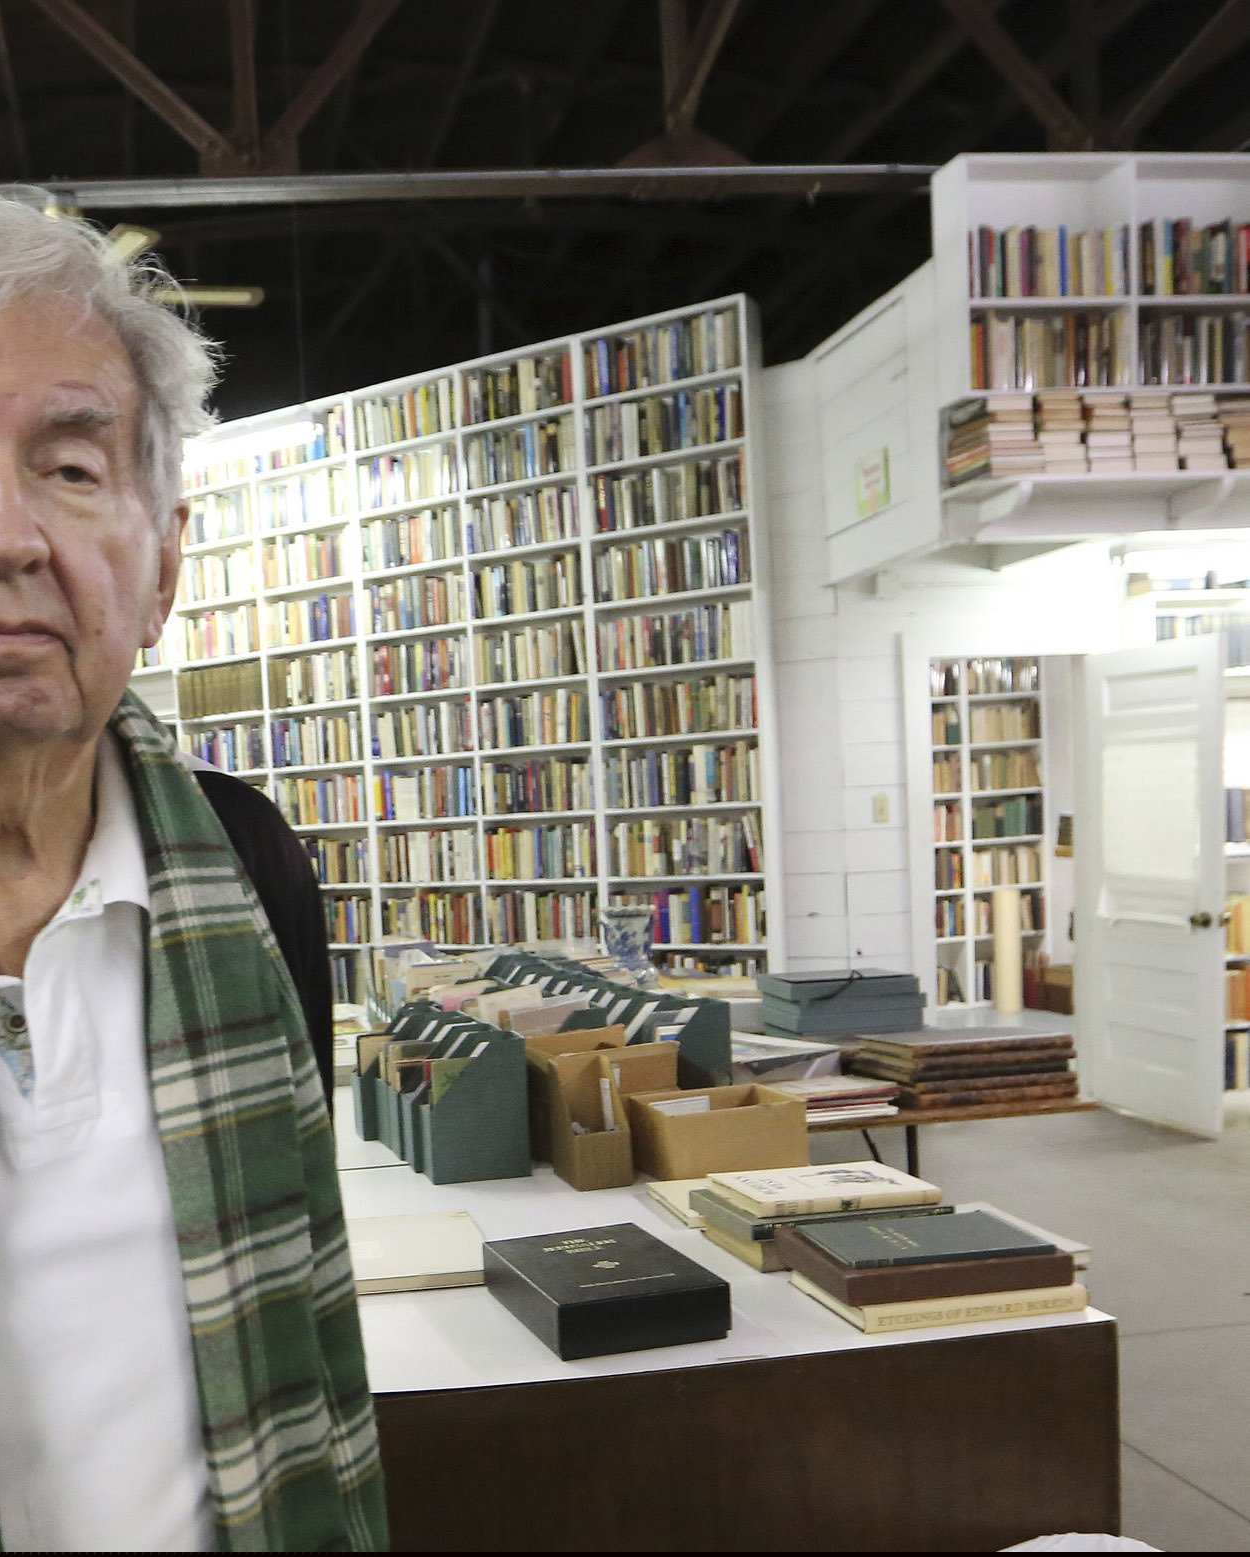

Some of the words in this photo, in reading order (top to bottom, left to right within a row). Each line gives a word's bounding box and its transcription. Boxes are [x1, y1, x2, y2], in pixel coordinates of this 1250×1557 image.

[877, 1311, 943, 1327] ETCHINGS
[945, 1308, 962, 1320] OF
[965, 1302, 1024, 1318] EDWARD
